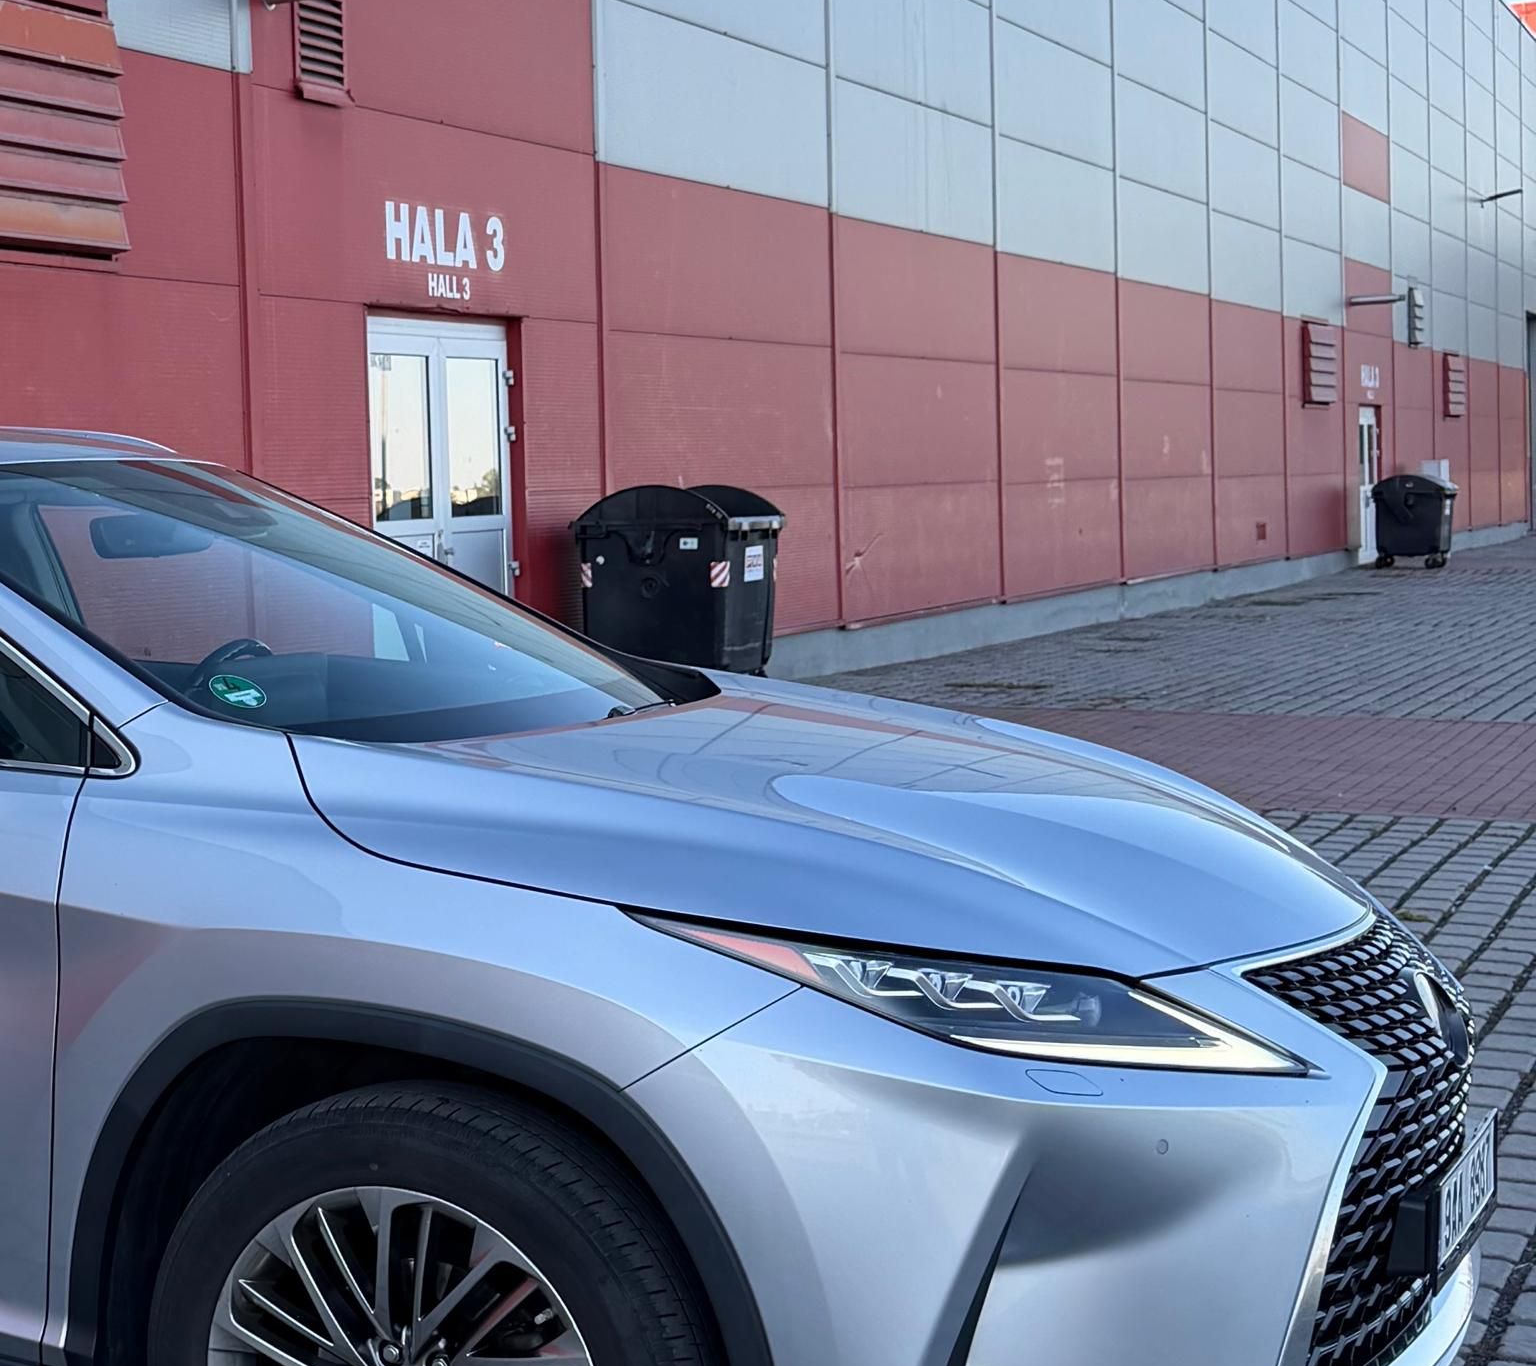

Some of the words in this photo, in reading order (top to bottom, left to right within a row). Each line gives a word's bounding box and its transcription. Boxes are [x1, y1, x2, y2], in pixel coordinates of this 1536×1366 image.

[385, 200, 478, 270] HALA
[486, 216, 506, 272] 3
[427, 272, 461, 300] HALL
[462, 277, 471, 301] 3
[1444, 1168, 1465, 1249] 9AA
